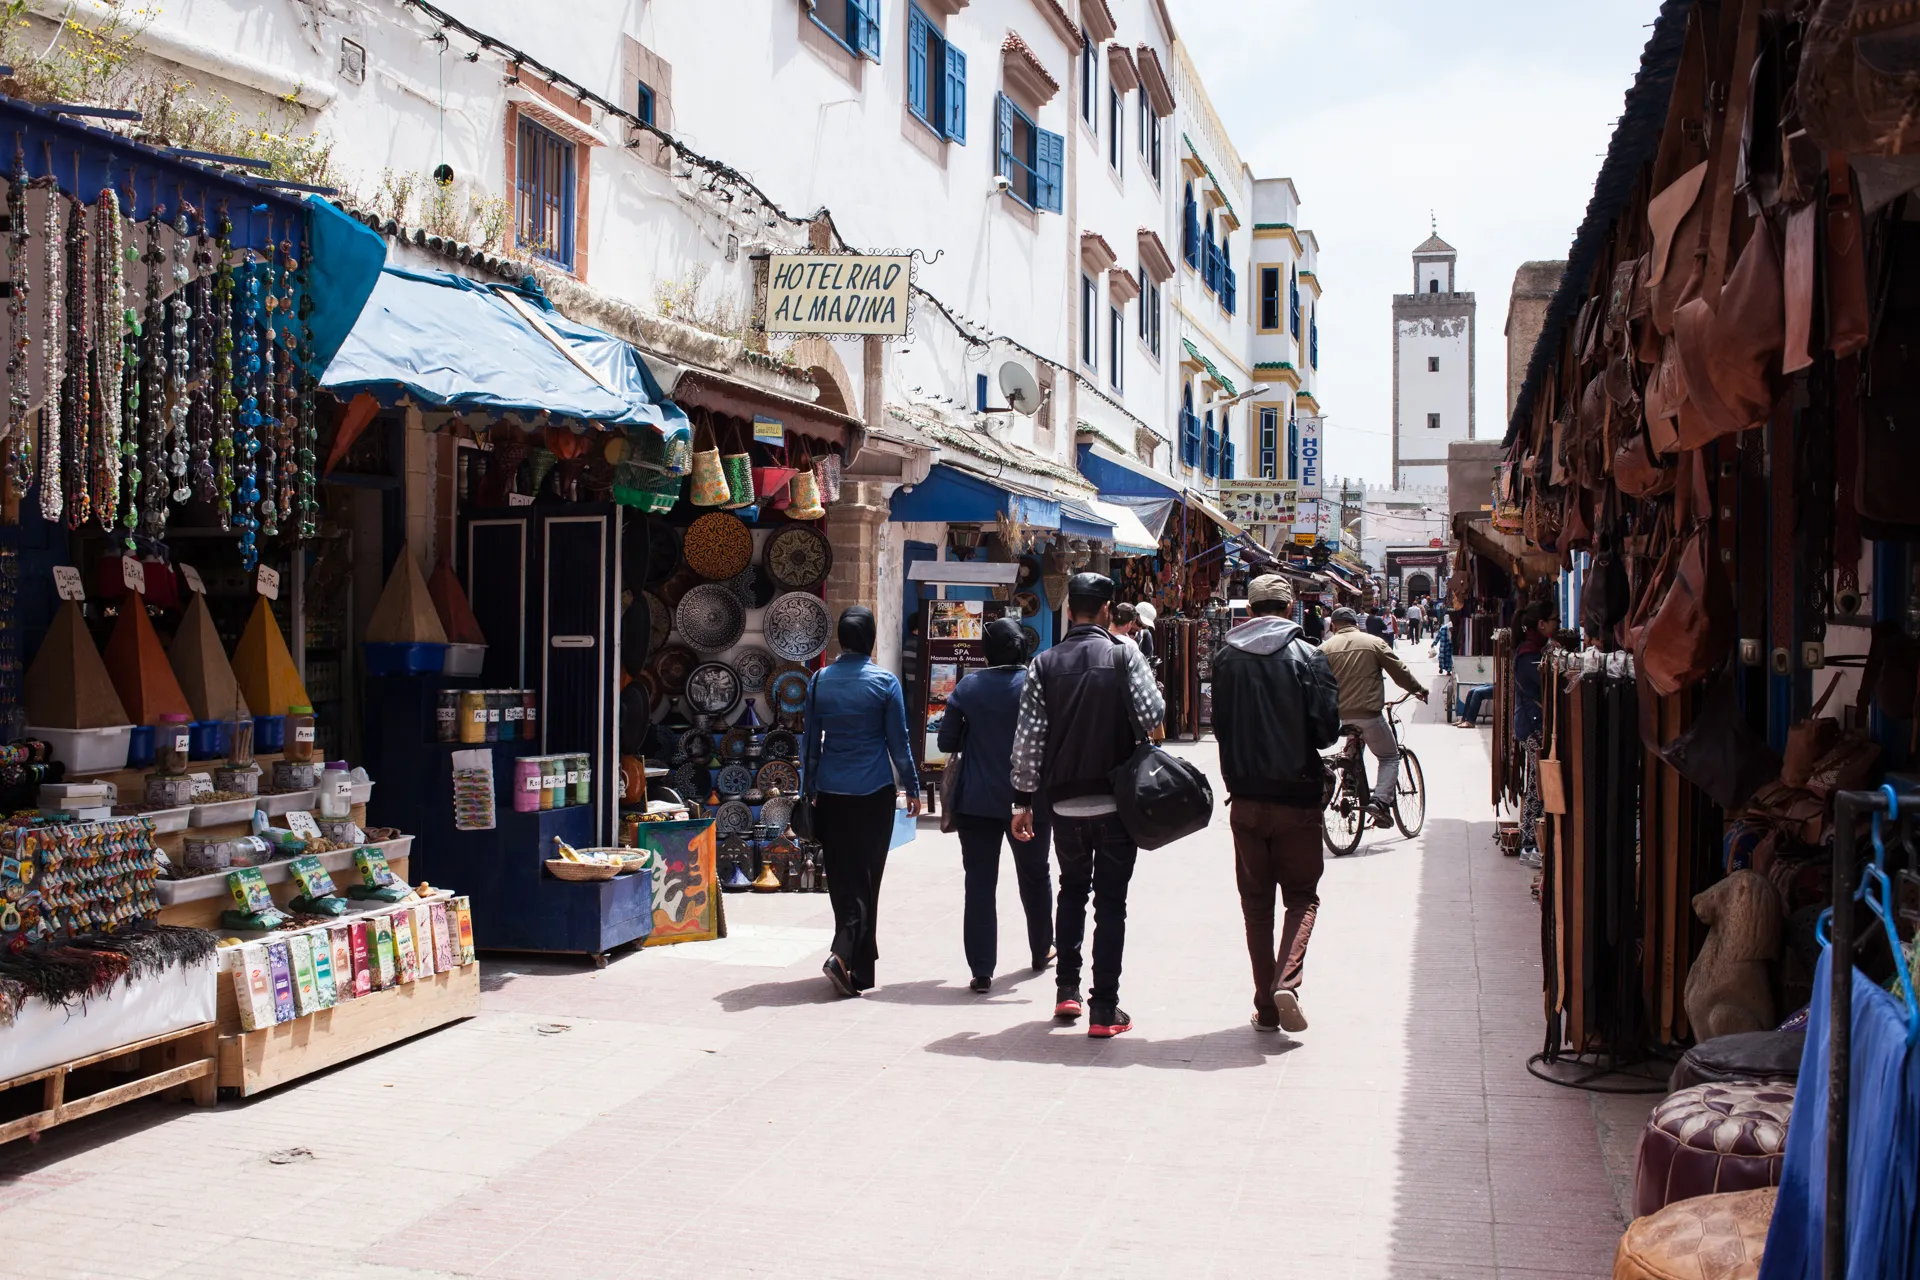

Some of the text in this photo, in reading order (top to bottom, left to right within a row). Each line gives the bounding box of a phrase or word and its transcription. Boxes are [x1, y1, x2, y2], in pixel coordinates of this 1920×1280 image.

[773, 263, 902, 291] HOTEL RIAD
[775, 295, 896, 323] AL MADINA
[1302, 438, 1318, 486] HOTEL
[1230, 480, 1262, 488] Boutique
[954, 648, 970, 656] SPA
